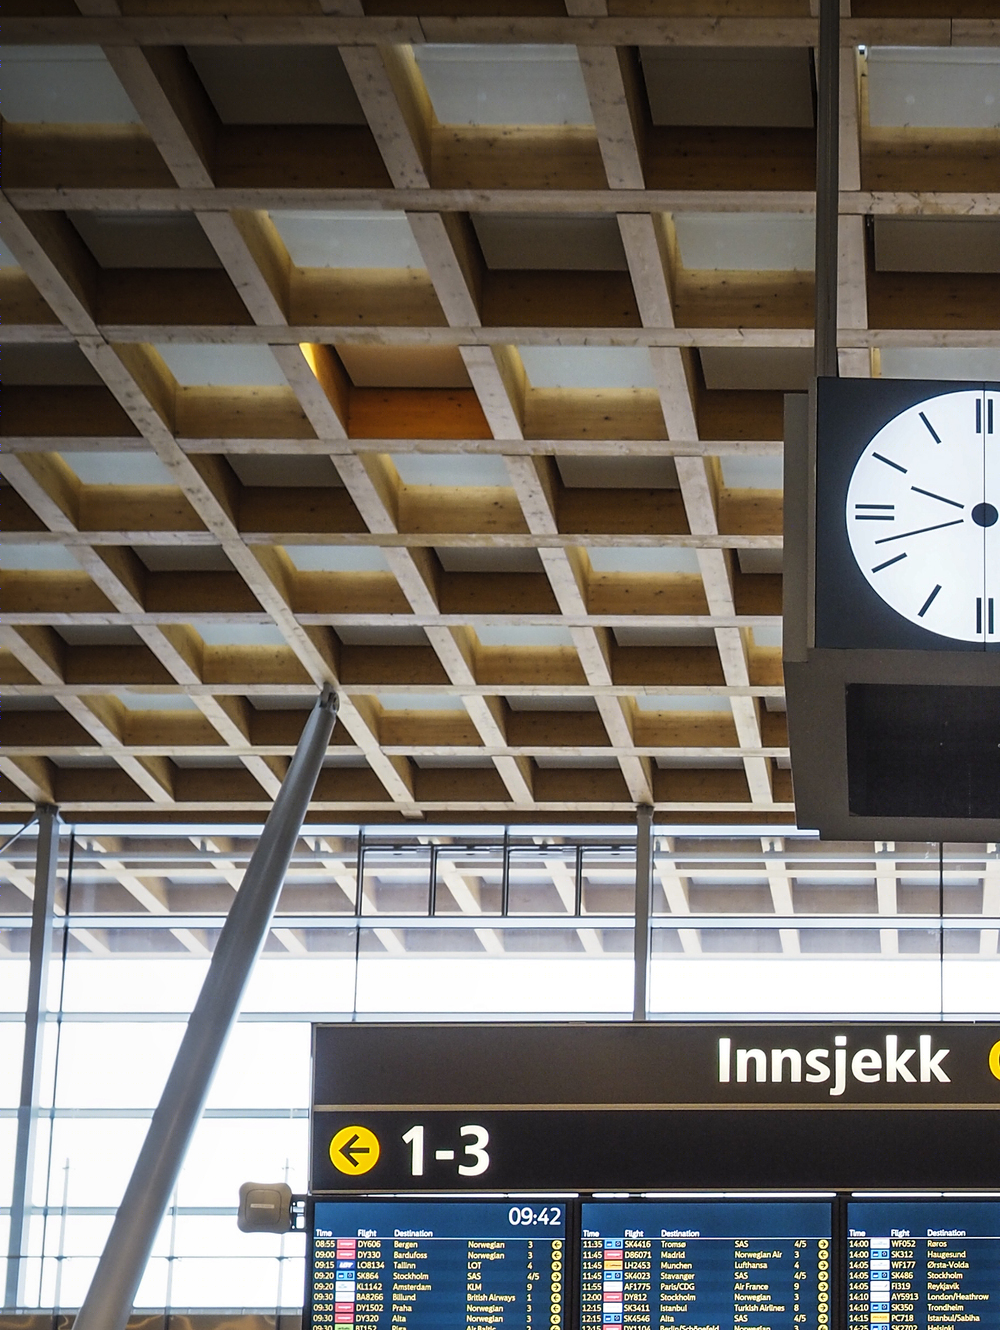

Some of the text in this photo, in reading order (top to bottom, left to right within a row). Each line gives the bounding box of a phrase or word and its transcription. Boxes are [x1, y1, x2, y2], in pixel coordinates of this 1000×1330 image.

[717, 1034, 952, 1096] Innsjekk
[401, 1124, 490, 1177] 1-3
[508, 1206, 561, 1226] 09:42
[316, 1229, 433, 1239] Time Flight Destination
[584, 1229, 699, 1239] Time Flight Destination
[849, 1228, 966, 1238] Time Flight Destination
[316, 1239, 335, 1248] 08:55
[394, 1240, 418, 1250] Bergen
[468, 1240, 505, 1250] Norwegian
[528, 1240, 533, 1249] 3
[315, 1260, 335, 1269] 09:15
[393, 1261, 416, 1270] Tallinn
[467, 1261, 482, 1270] LOT
[527, 1261, 533, 1270] 4
